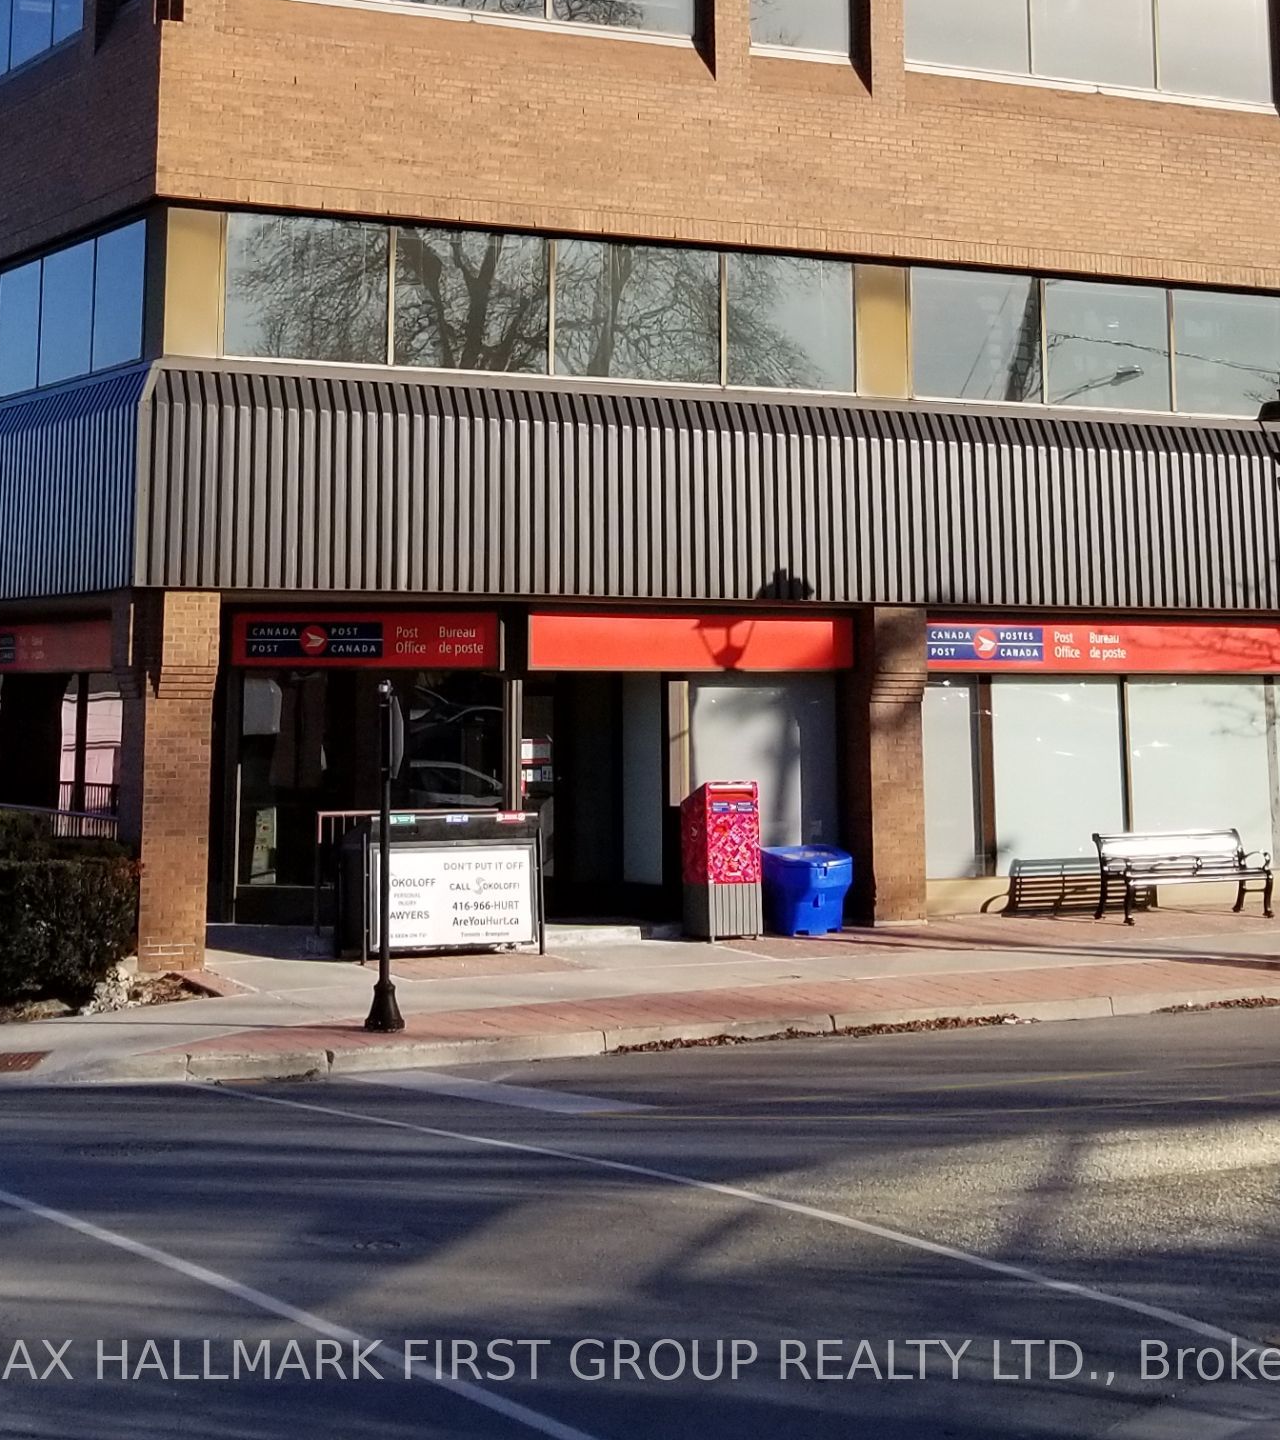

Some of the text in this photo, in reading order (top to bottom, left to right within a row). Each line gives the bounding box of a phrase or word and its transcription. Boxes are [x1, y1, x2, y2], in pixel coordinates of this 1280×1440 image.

[251, 627, 358, 636] CANADA POST
[396, 626, 419, 638] Post
[439, 626, 476, 638] Bureau
[931, 631, 1034, 641] CANADA POSTES
[1054, 631, 1074, 643] Post
[1089, 632, 1119, 644] Bureau
[252, 644, 376, 653] POST CANADA
[395, 641, 426, 654] Office
[439, 642, 484, 657] de poste
[931, 647, 1039, 657] POST CANADA
[1054, 646, 1080, 658] Office
[1089, 647, 1127, 660] de poste
[475, 862, 492, 870] PUT
[495, 862, 504, 870] IT
[506, 862, 524, 870] OFF
[390, 878, 436, 887] OKOLOFF
[449, 883, 471, 891] CALL
[452, 901, 520, 911] 416-966-HURT
[389, 910, 430, 920] AWYERS
[452, 916, 520, 927] AreYouHurt.ca
